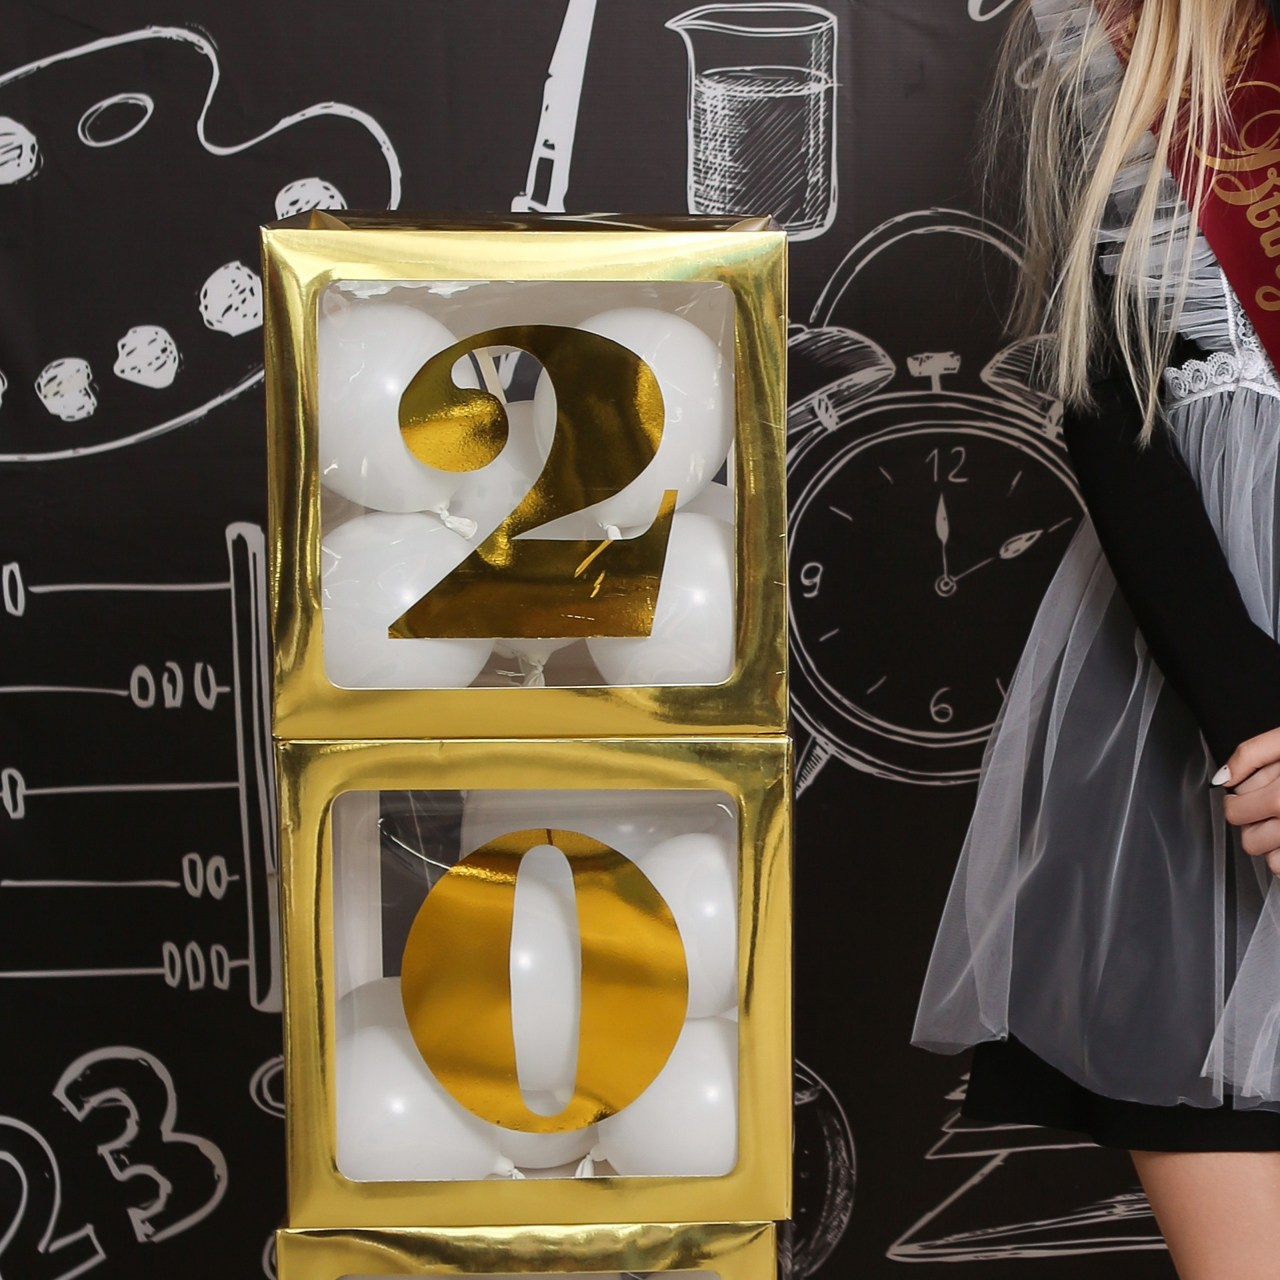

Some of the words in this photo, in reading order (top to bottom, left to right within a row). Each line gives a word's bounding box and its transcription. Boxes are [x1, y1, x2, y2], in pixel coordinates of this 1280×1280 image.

[923, 446, 969, 483] 12
[800, 562, 824, 599] 9
[929, 686, 954, 724] 6
